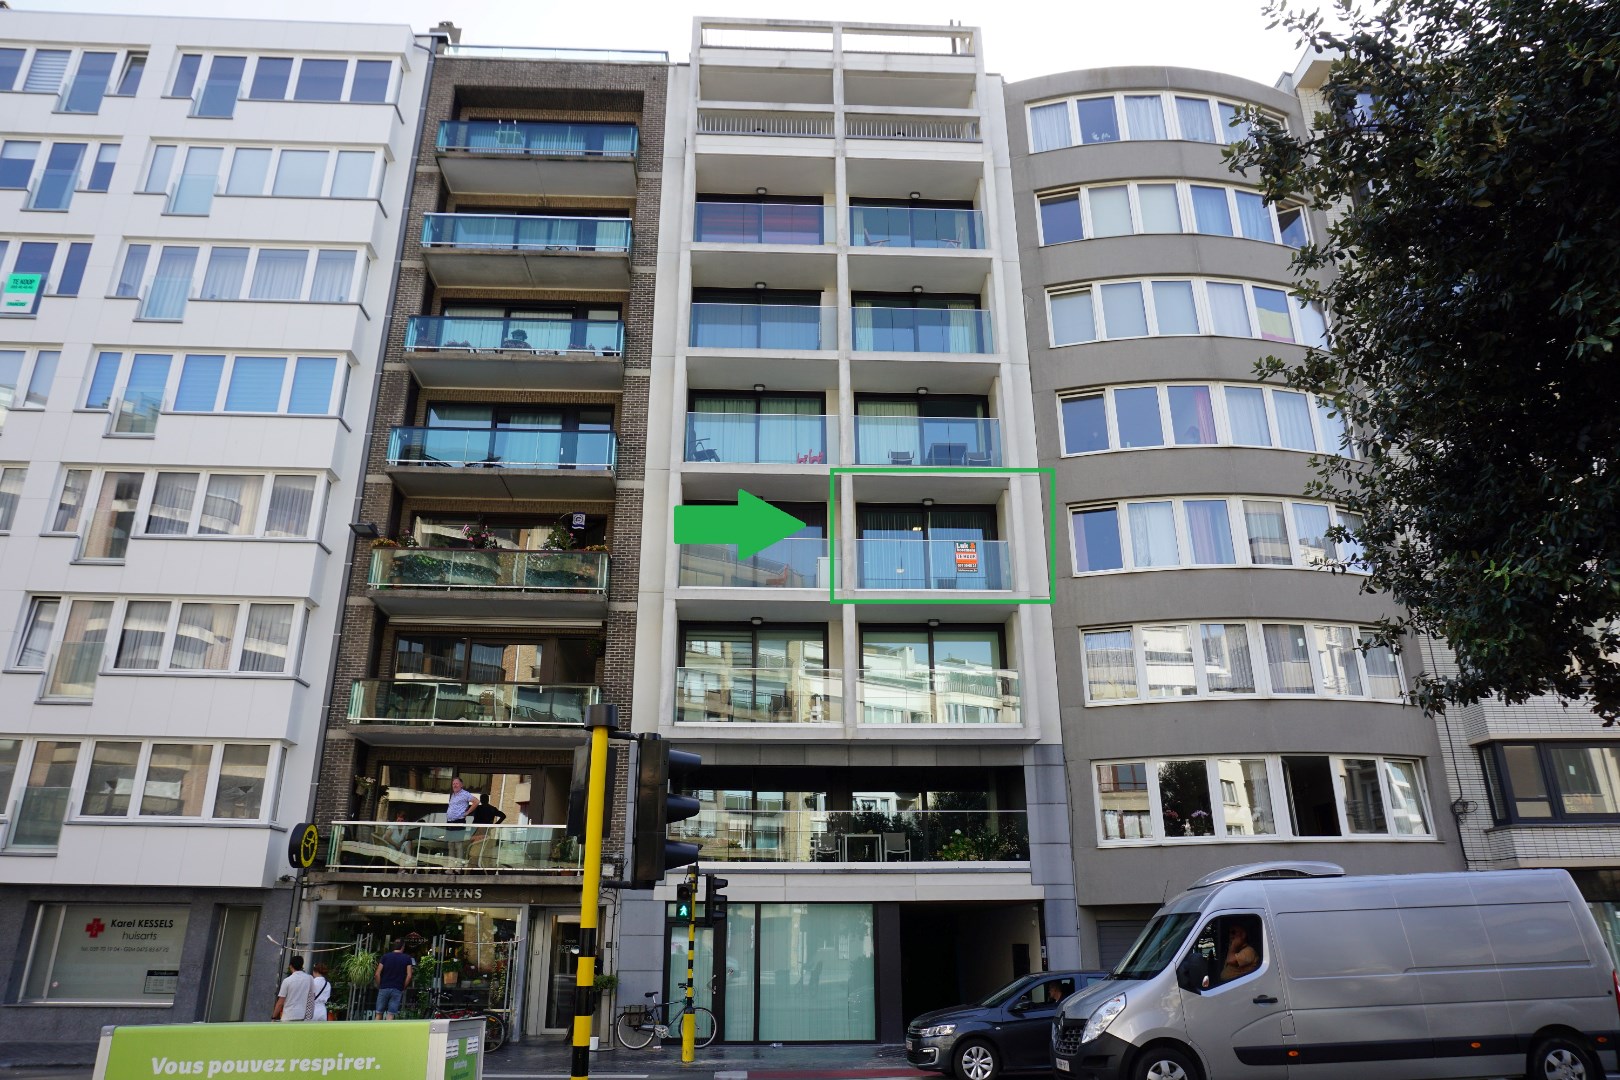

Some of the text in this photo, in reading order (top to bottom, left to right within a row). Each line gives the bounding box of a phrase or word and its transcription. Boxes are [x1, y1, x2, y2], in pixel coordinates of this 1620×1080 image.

[362, 886, 482, 899] FLORIST MEYNS
[110, 919, 174, 928] Karel KESSELS
[122, 931, 157, 940] huisarts
[152, 1053, 381, 1078] Vous pouvez respirer.
